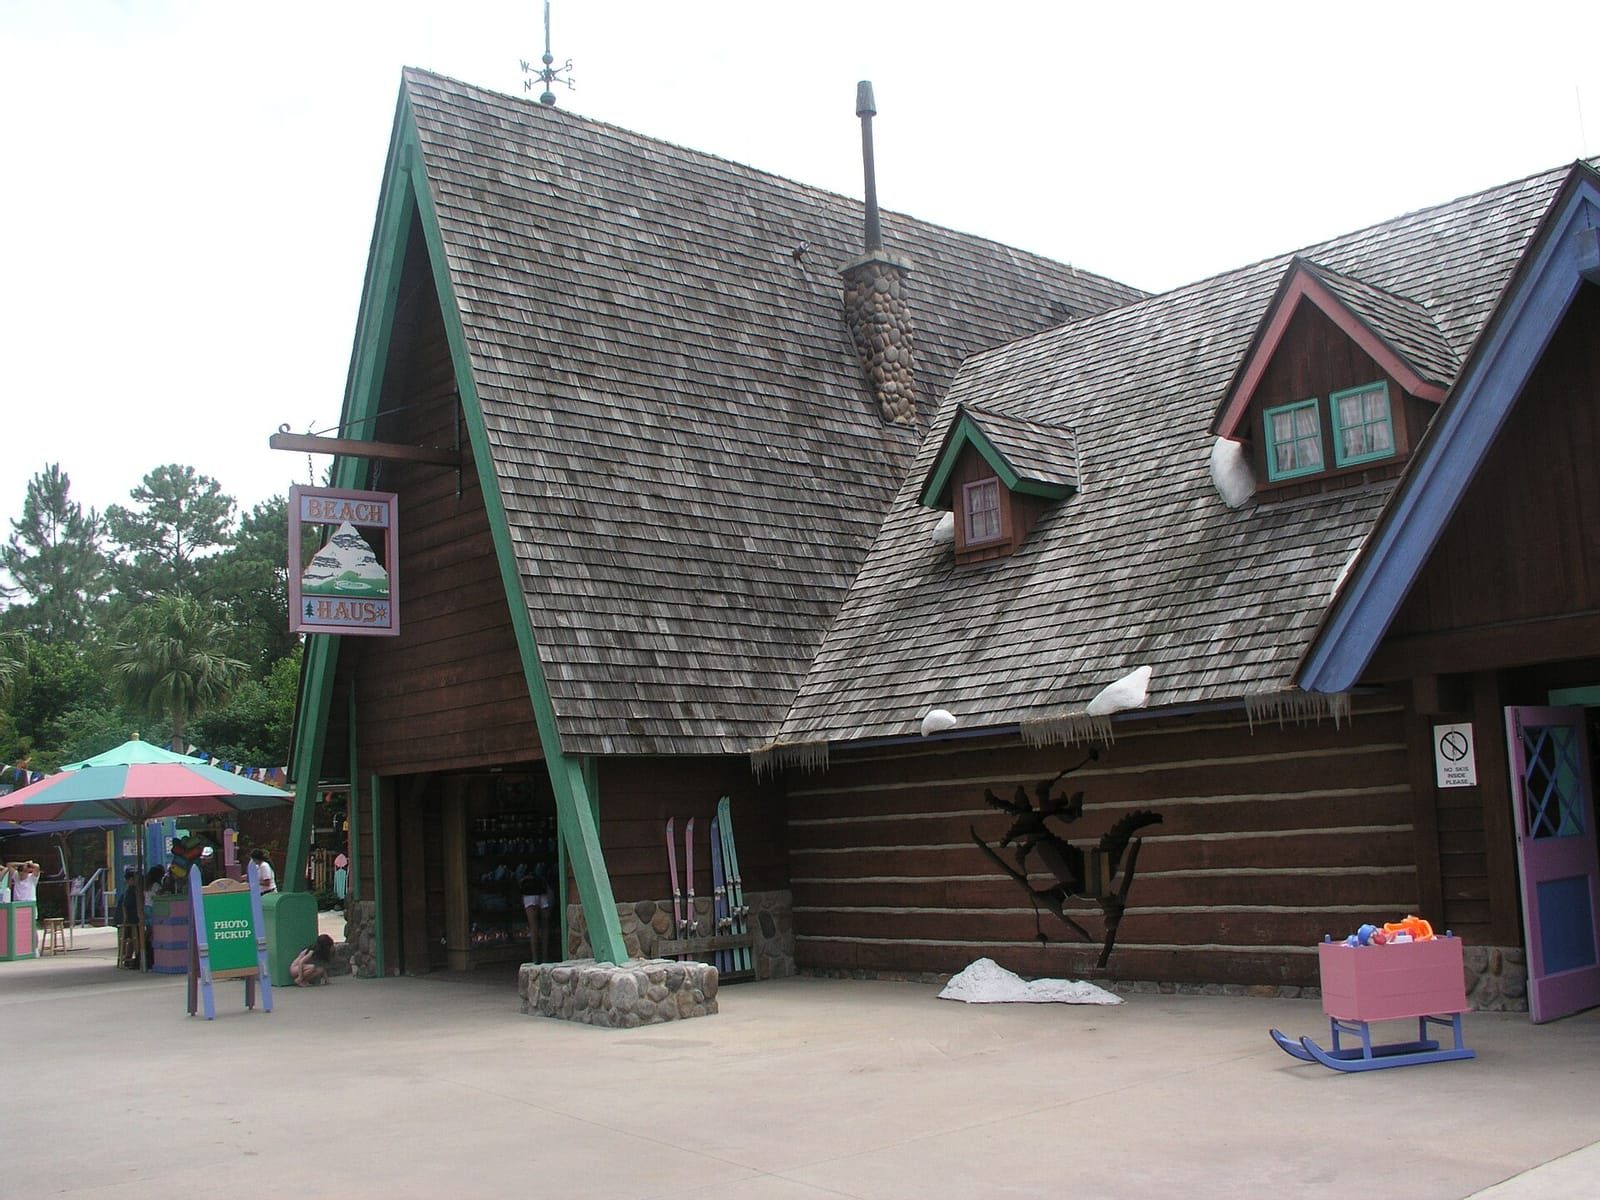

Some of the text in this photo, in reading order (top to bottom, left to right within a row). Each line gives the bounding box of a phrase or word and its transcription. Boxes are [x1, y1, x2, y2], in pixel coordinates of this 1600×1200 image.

[520, 59, 530, 73] W
[565, 58, 573, 72] S
[524, 78, 531, 93] N
[568, 77, 576, 91] E
[308, 499, 384, 524] BEACH
[317, 600, 377, 623] HAUS
[214, 920, 249, 930] PHOTO
[214, 930, 252, 940] PICKUP
